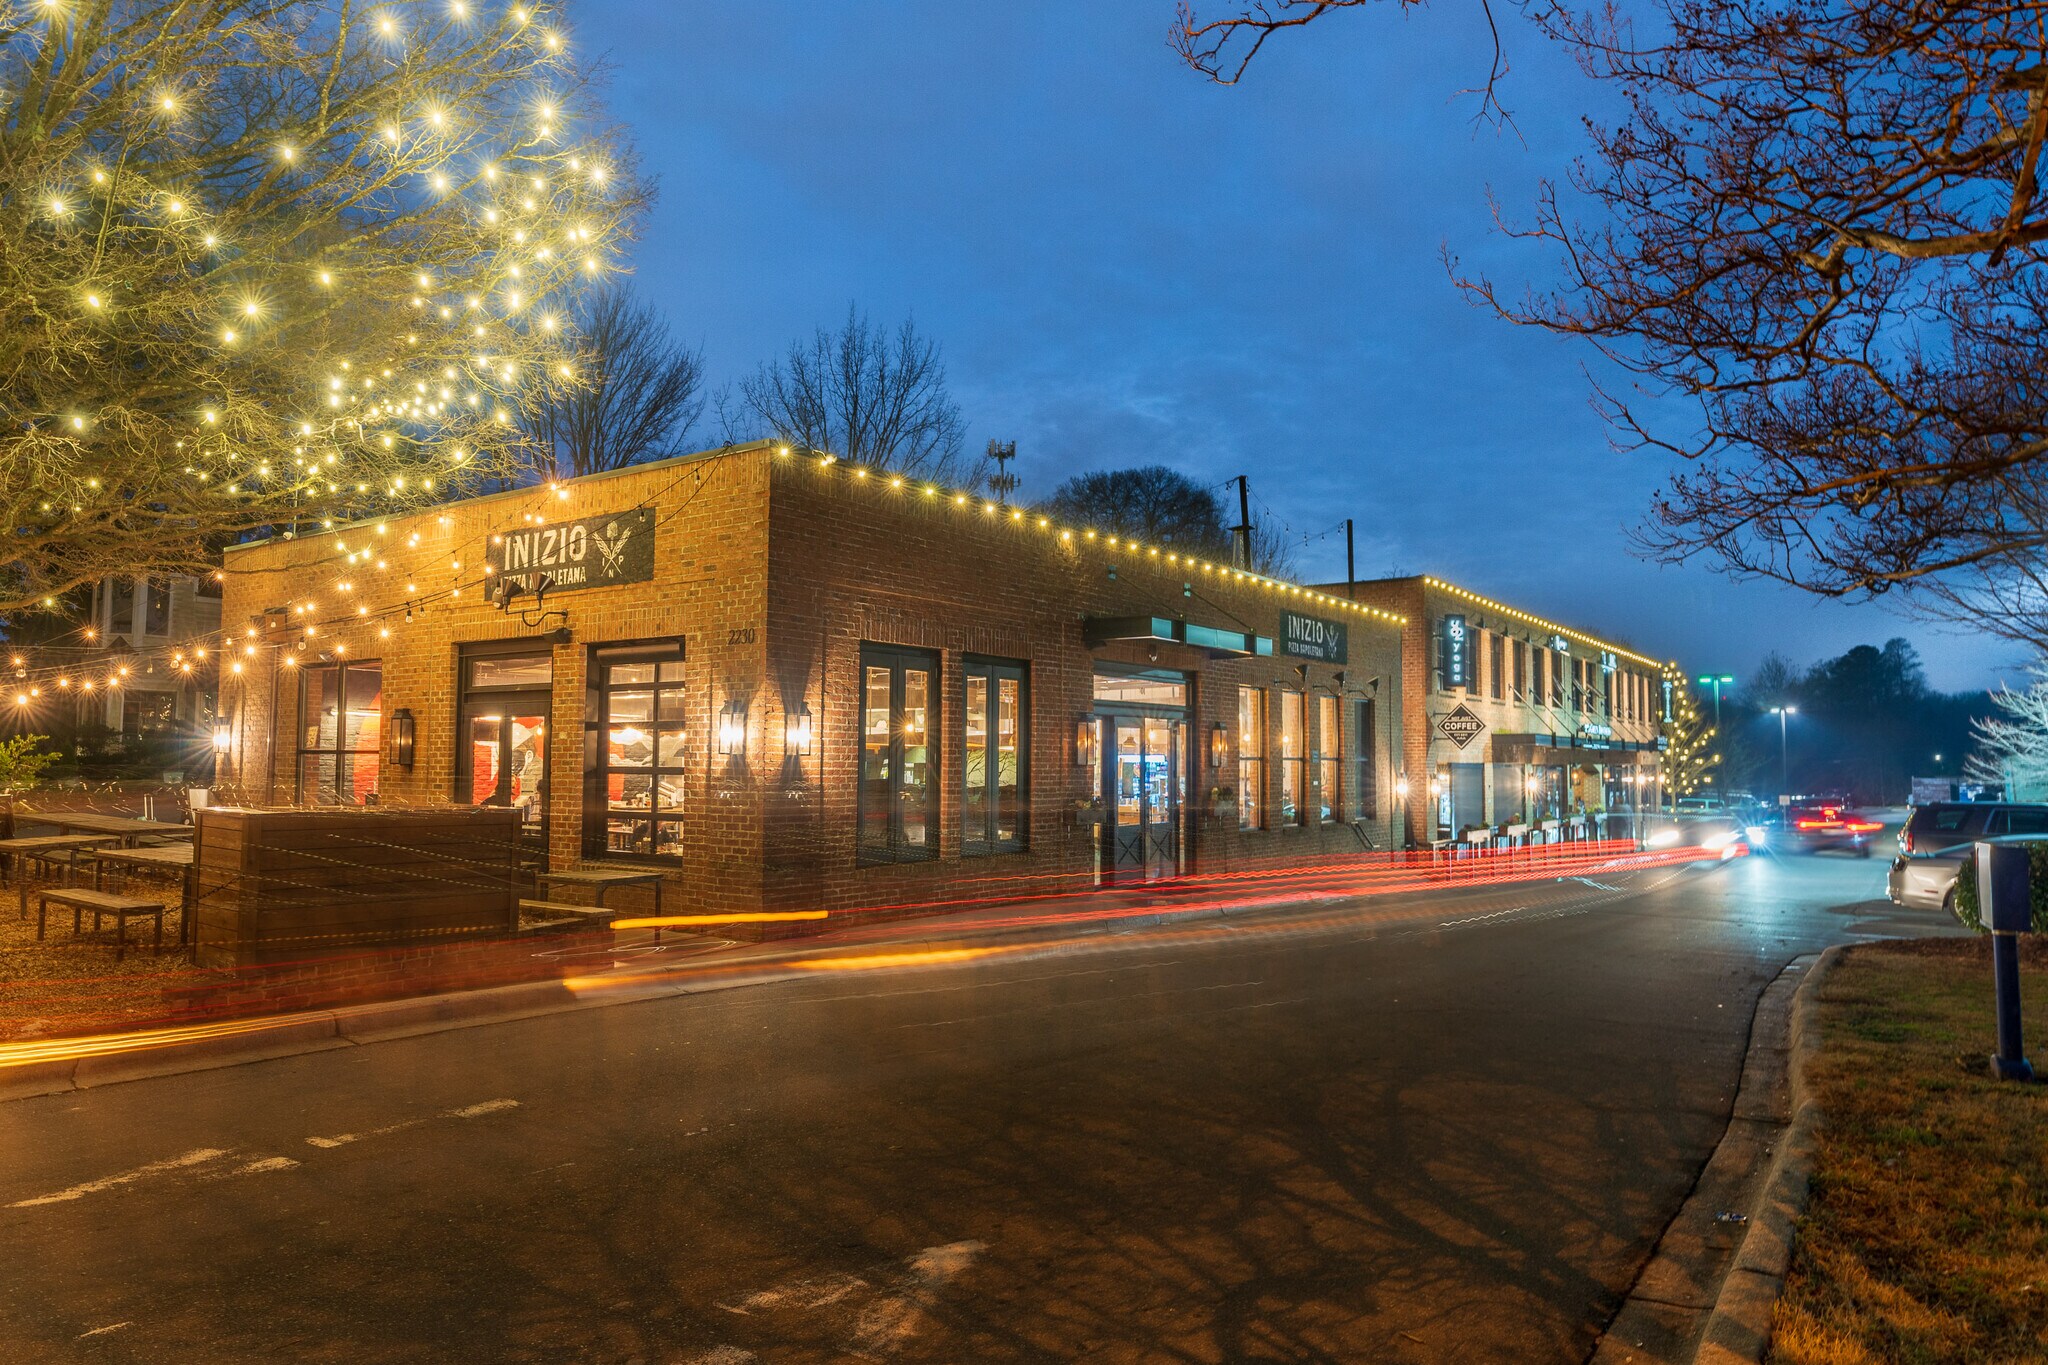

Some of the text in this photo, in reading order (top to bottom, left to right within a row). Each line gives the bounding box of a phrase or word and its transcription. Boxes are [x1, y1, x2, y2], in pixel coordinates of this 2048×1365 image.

[504, 525, 587, 571] INIZIO
[529, 566, 587, 589] OLETANA
[608, 569, 614, 578] N
[728, 627, 755, 646] 2230
[1288, 615, 1323, 644] INIZIO
[1453, 642, 1461, 681] yoga
[1444, 722, 1477, 730] COFFEE
